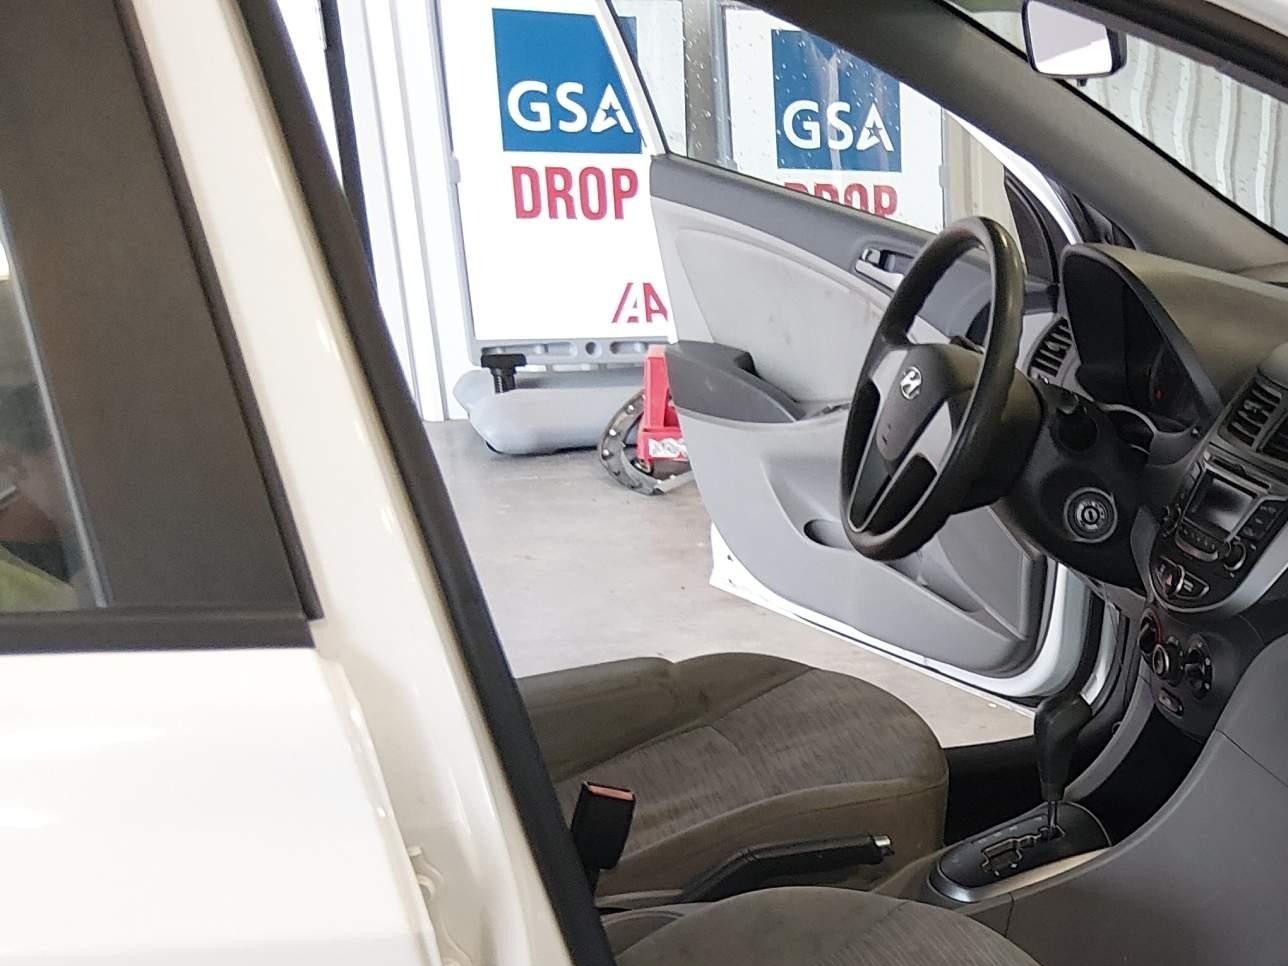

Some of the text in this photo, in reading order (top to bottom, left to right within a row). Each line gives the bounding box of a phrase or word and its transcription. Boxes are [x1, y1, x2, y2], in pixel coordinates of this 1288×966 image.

[507, 80, 634, 133] GSA
[783, 99, 895, 152] GSA
[511, 165, 639, 221] DROP
